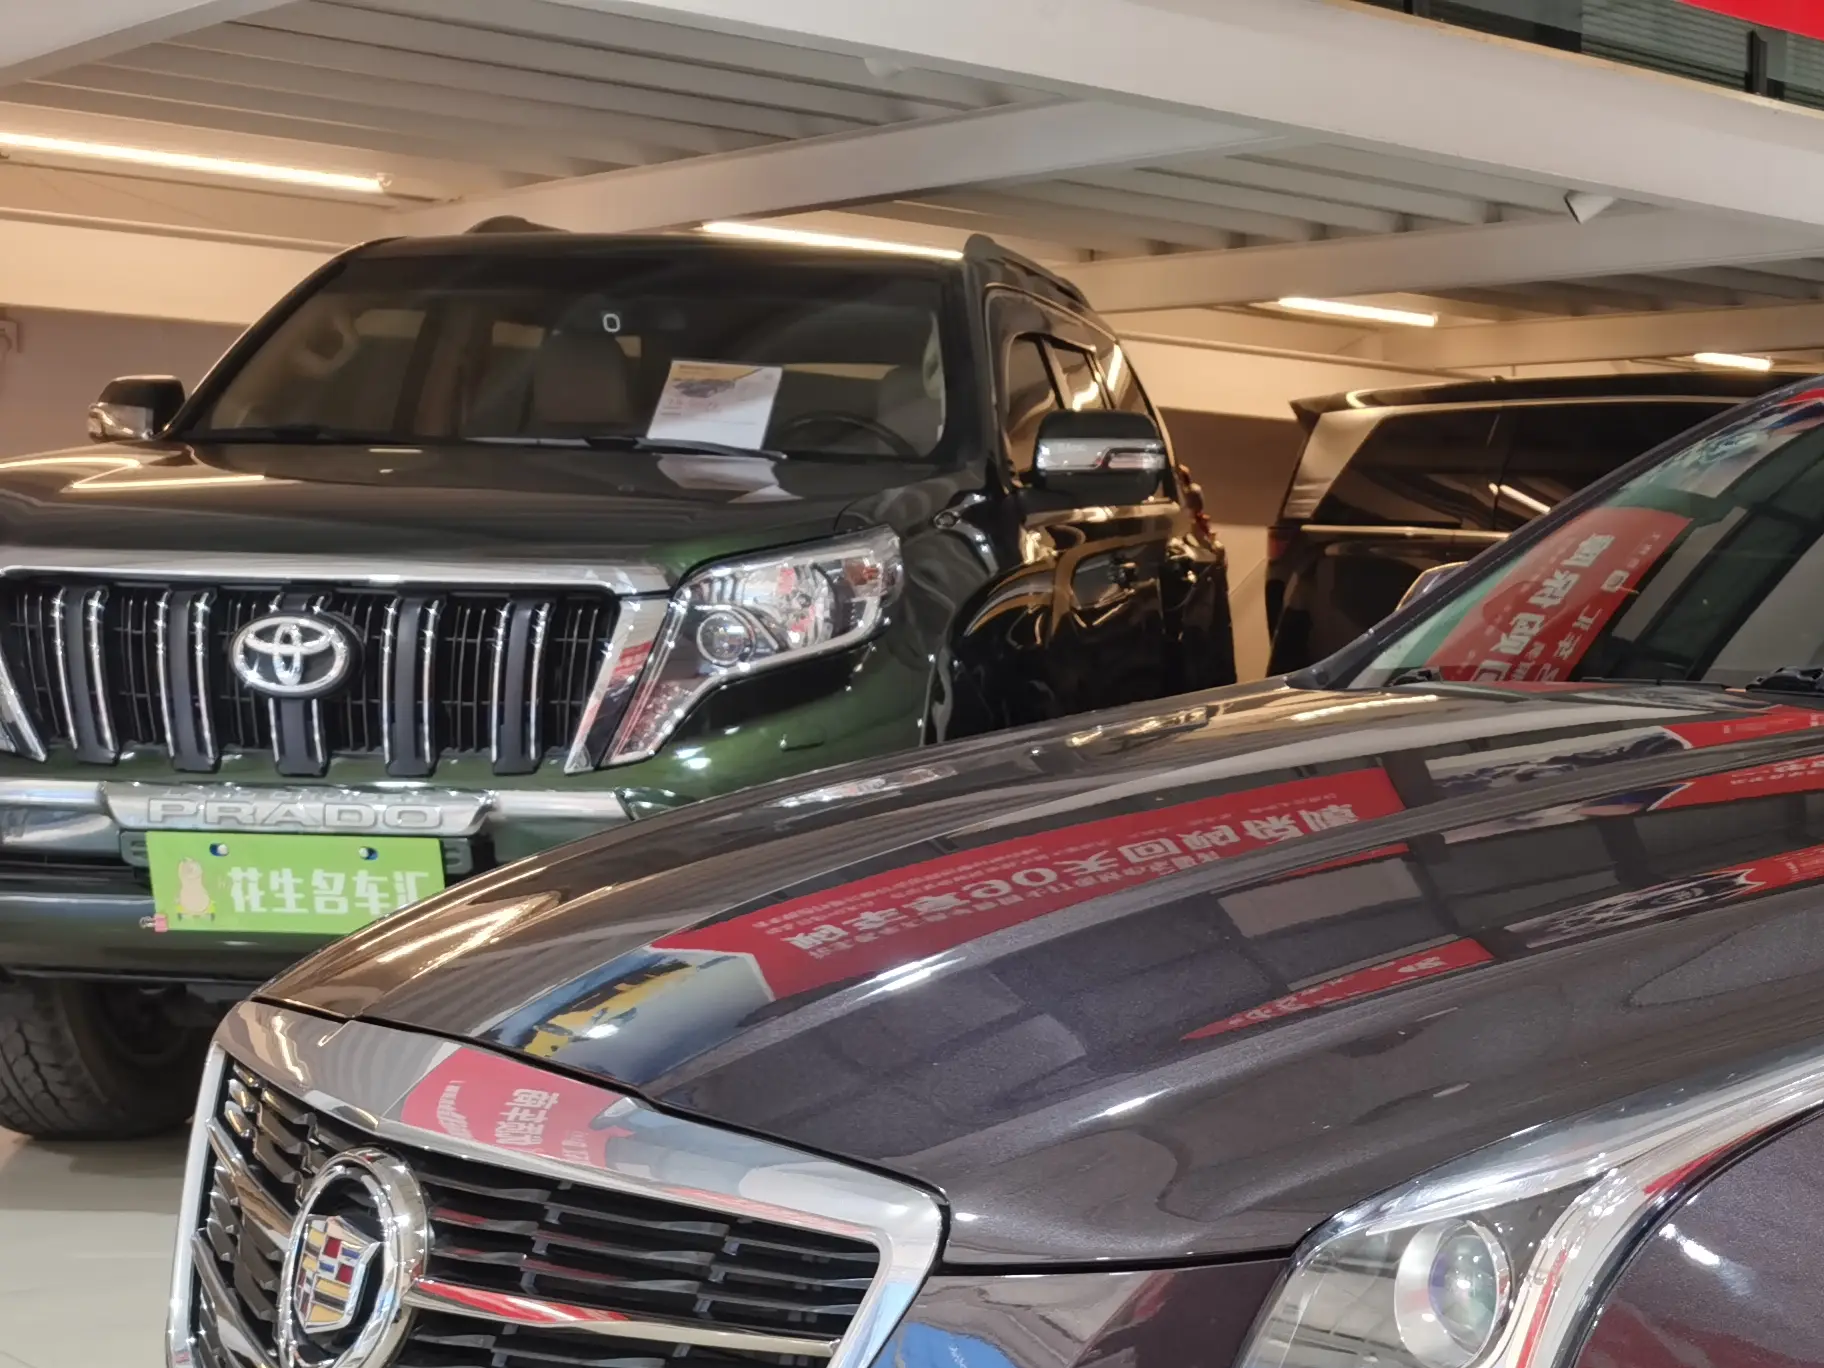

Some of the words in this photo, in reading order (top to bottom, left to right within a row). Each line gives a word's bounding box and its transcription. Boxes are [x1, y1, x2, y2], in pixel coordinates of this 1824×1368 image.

[150, 799, 443, 829] PRADO
[226, 866, 430, 916] 花生名车汇
